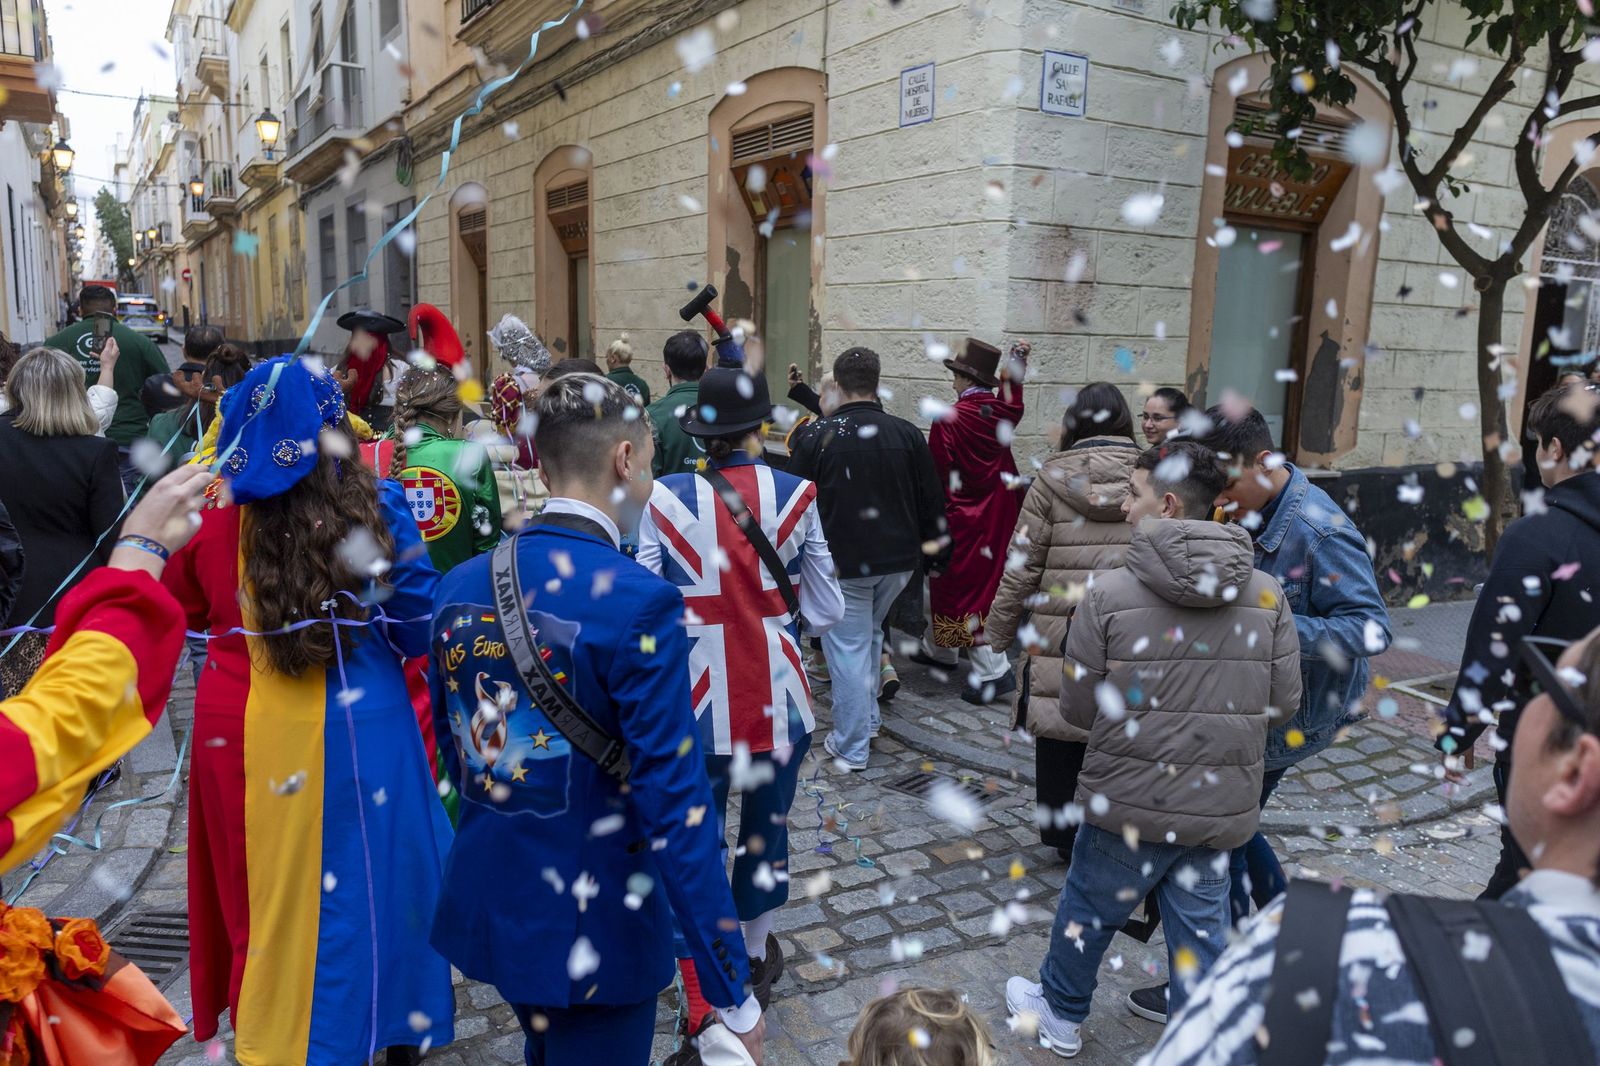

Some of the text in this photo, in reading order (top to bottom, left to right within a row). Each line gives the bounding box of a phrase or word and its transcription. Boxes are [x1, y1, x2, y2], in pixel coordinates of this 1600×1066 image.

[1052, 61, 1080, 76] CALLE
[908, 72, 927, 86] CALLE
[1055, 79, 1069, 90] SA
[913, 96, 921, 107] DE
[1047, 92, 1080, 109] RAFAEL
[1236, 152, 1330, 187] CENO
[445, 642, 466, 671] LAS
